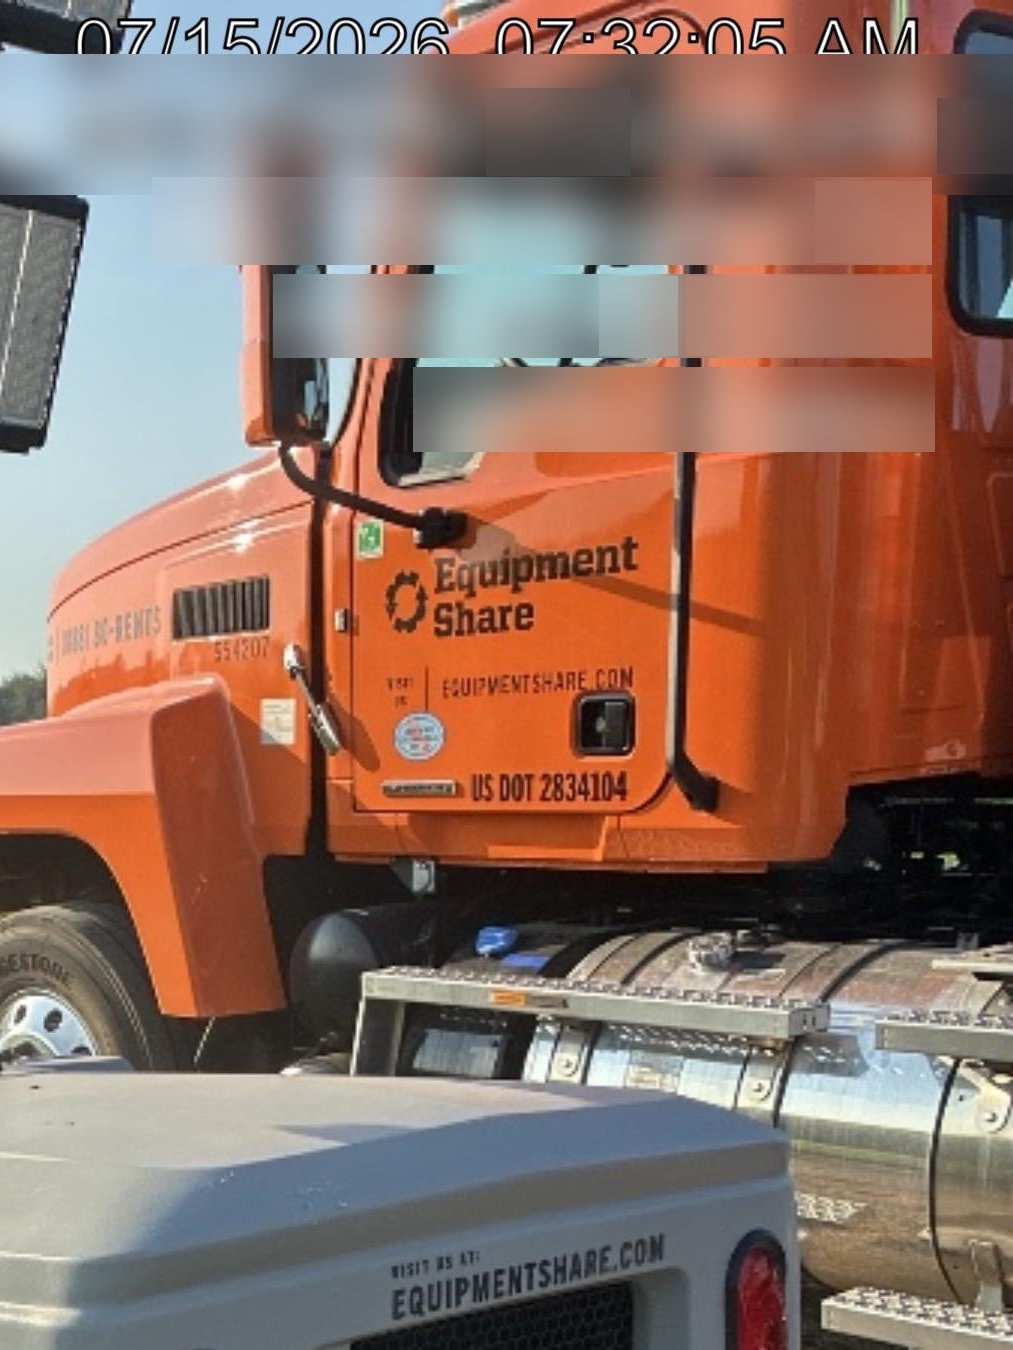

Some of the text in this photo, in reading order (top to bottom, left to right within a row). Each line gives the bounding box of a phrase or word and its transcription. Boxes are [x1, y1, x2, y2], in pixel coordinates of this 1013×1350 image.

[434, 536, 639, 598] Equipment
[434, 602, 535, 639] Share
[470, 773, 495, 802] US
[499, 774, 535, 802] DOT
[539, 770, 629, 802] 2834104
[392, 1233, 665, 1321] EQUIPMENTSHARE.COM
